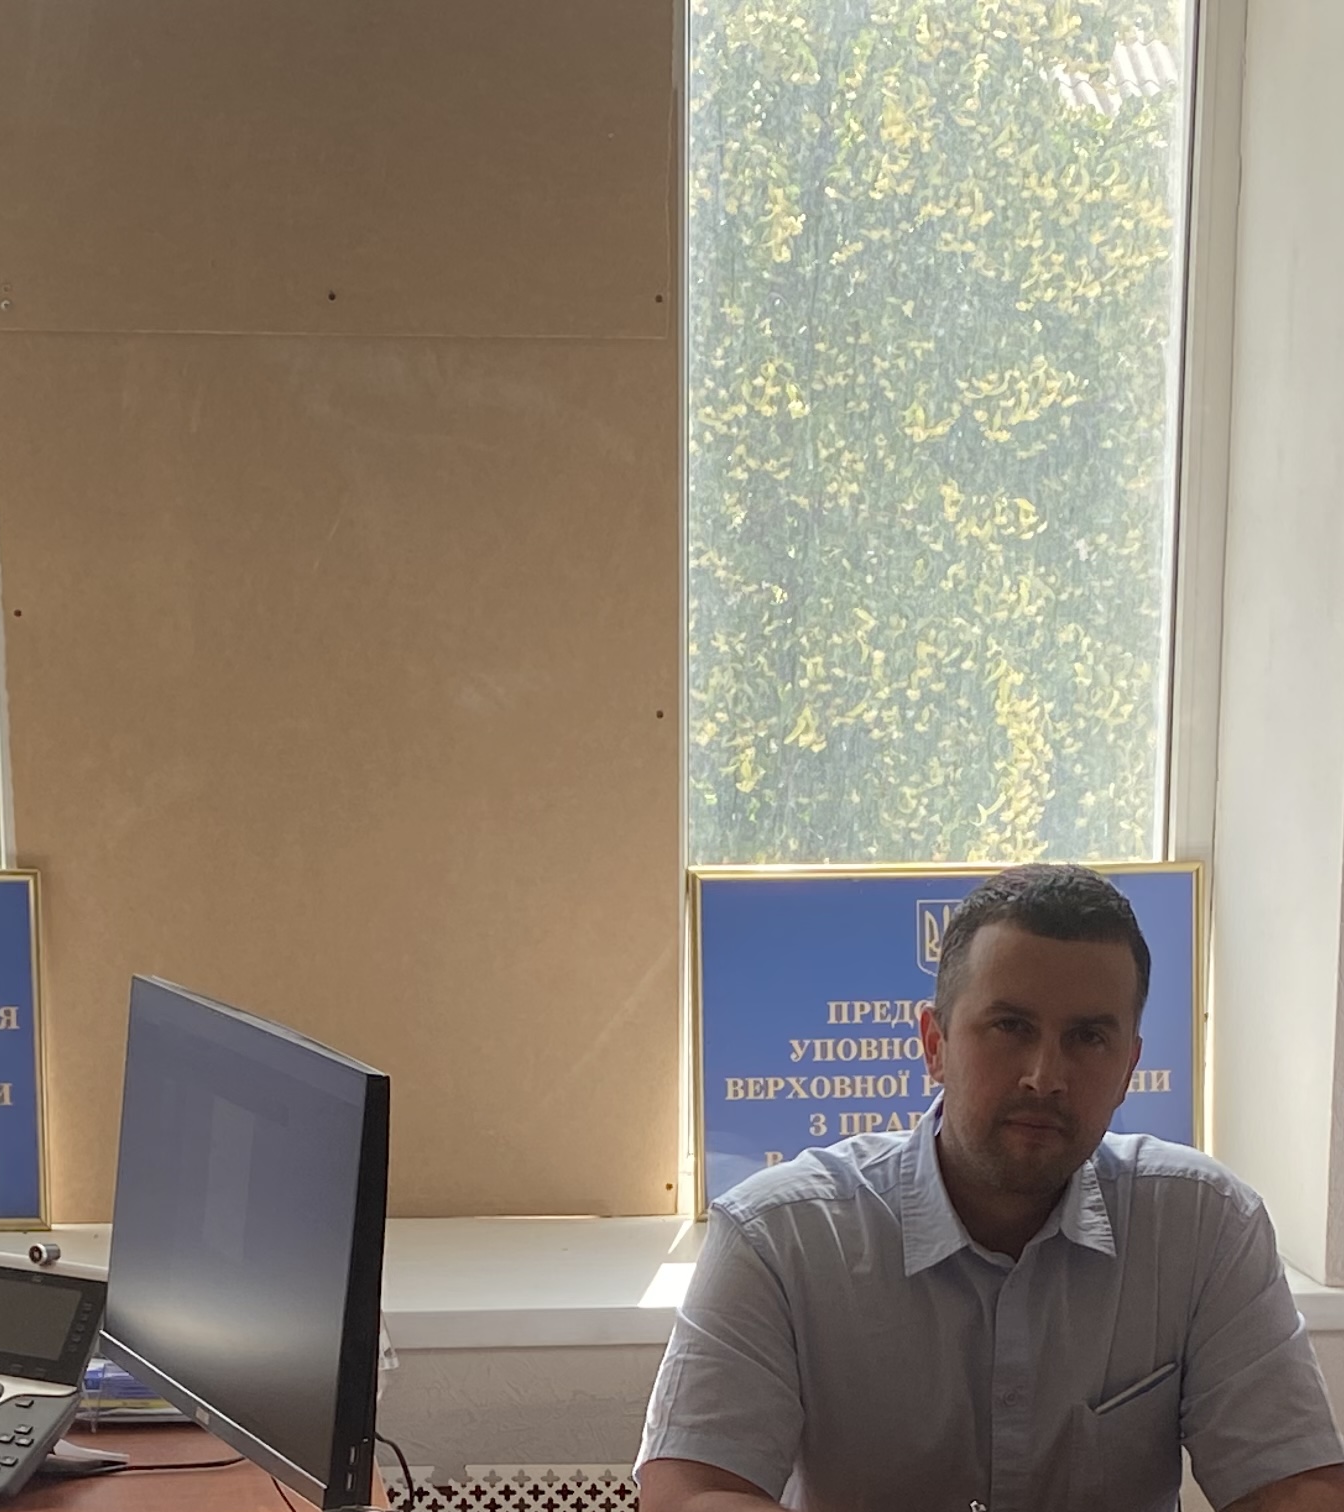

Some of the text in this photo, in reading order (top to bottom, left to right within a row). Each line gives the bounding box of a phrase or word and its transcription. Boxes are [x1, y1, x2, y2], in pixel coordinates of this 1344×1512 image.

[790, 1037, 925, 1063] УПОВНО
[725, 1070, 910, 1101] ВЕРХОВНОЇ
[809, 1112, 828, 1137] З
